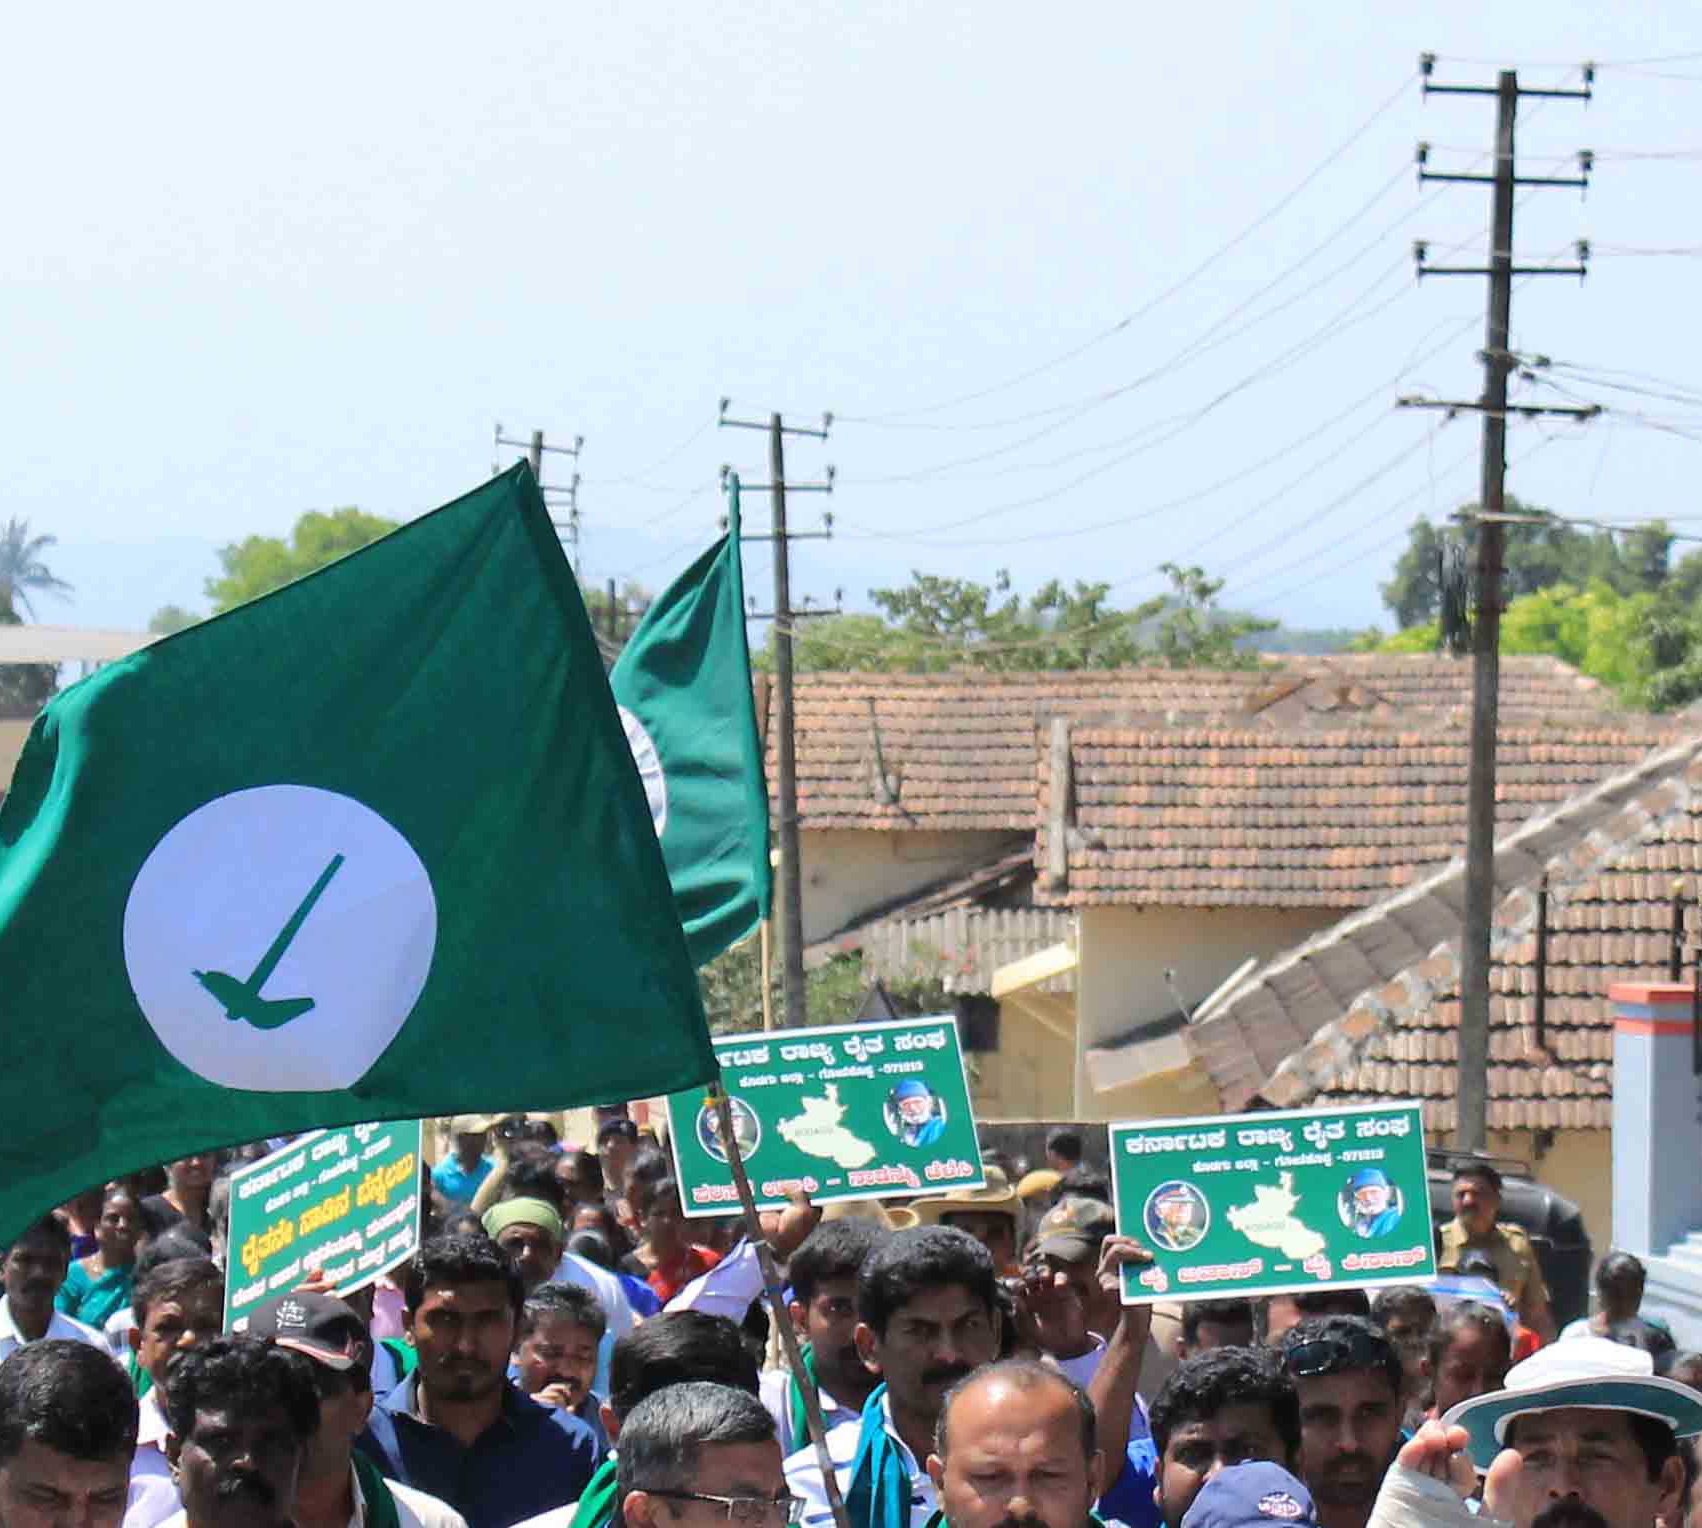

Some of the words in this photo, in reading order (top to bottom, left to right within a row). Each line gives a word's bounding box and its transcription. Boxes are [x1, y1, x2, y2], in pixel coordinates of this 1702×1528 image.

[780, 1042, 835, 1064] ರಾಜ್ಯ
[843, 1033, 884, 1061] ರೈತ
[1125, 1129, 1225, 1154] ಕರ್ನಾಟಕ
[1237, 1126, 1294, 1152] ರಾಜ್ಯ
[1303, 1118, 1346, 1149] ರೈತ
[1355, 1114, 1410, 1139] ಸಂಘ
